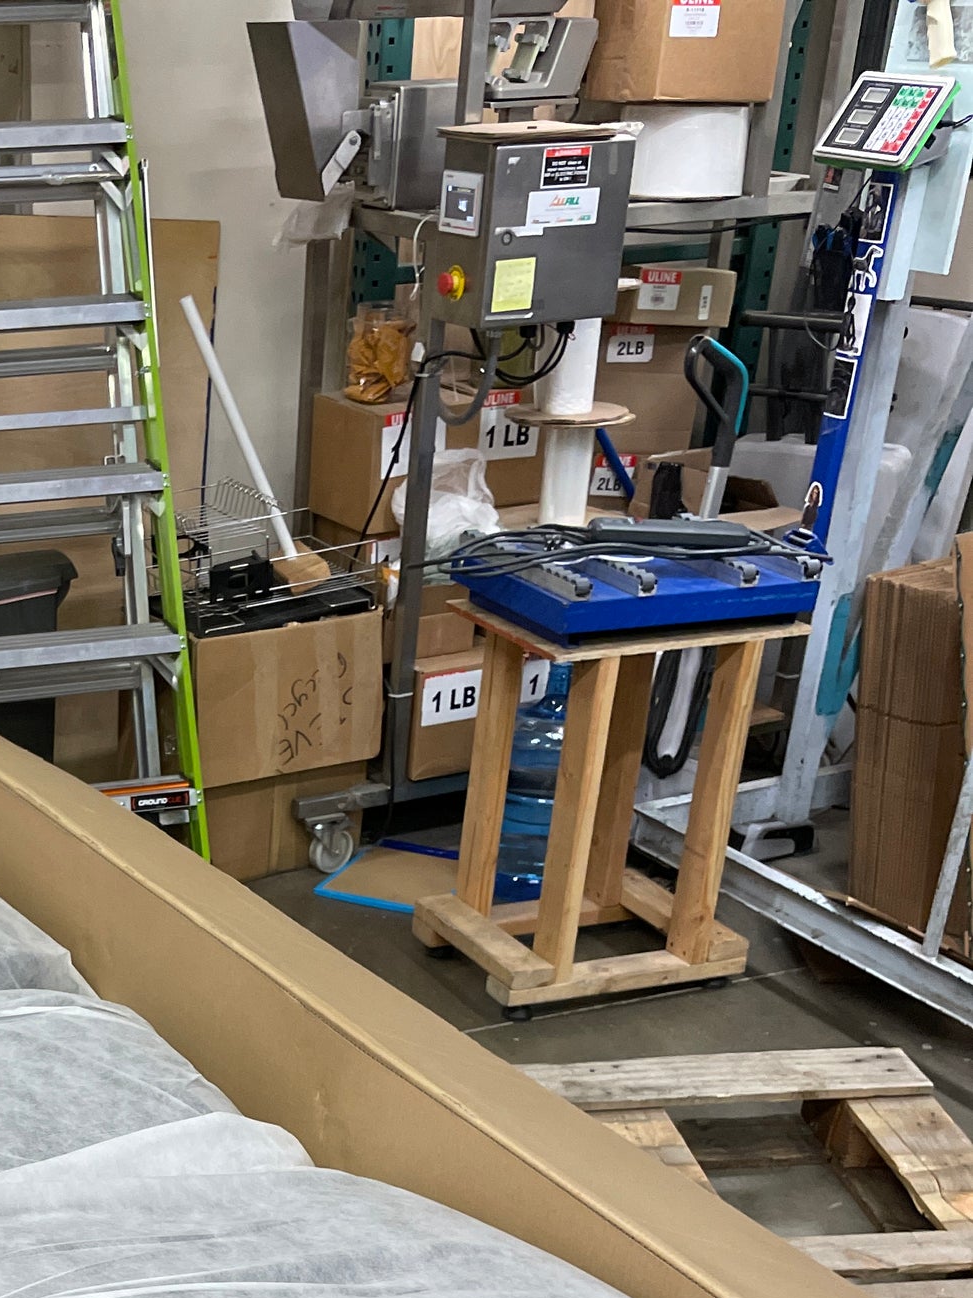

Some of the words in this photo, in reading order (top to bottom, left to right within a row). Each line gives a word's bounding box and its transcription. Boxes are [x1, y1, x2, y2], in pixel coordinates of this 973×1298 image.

[647, 271, 677, 283] ULINE
[617, 341, 645, 356] 2LB
[486, 425, 496, 449] 1
[503, 423, 531, 448] LB
[529, 673, 540, 696] 1
[432, 691, 442, 713] 1
[449, 686, 476, 710] LB
